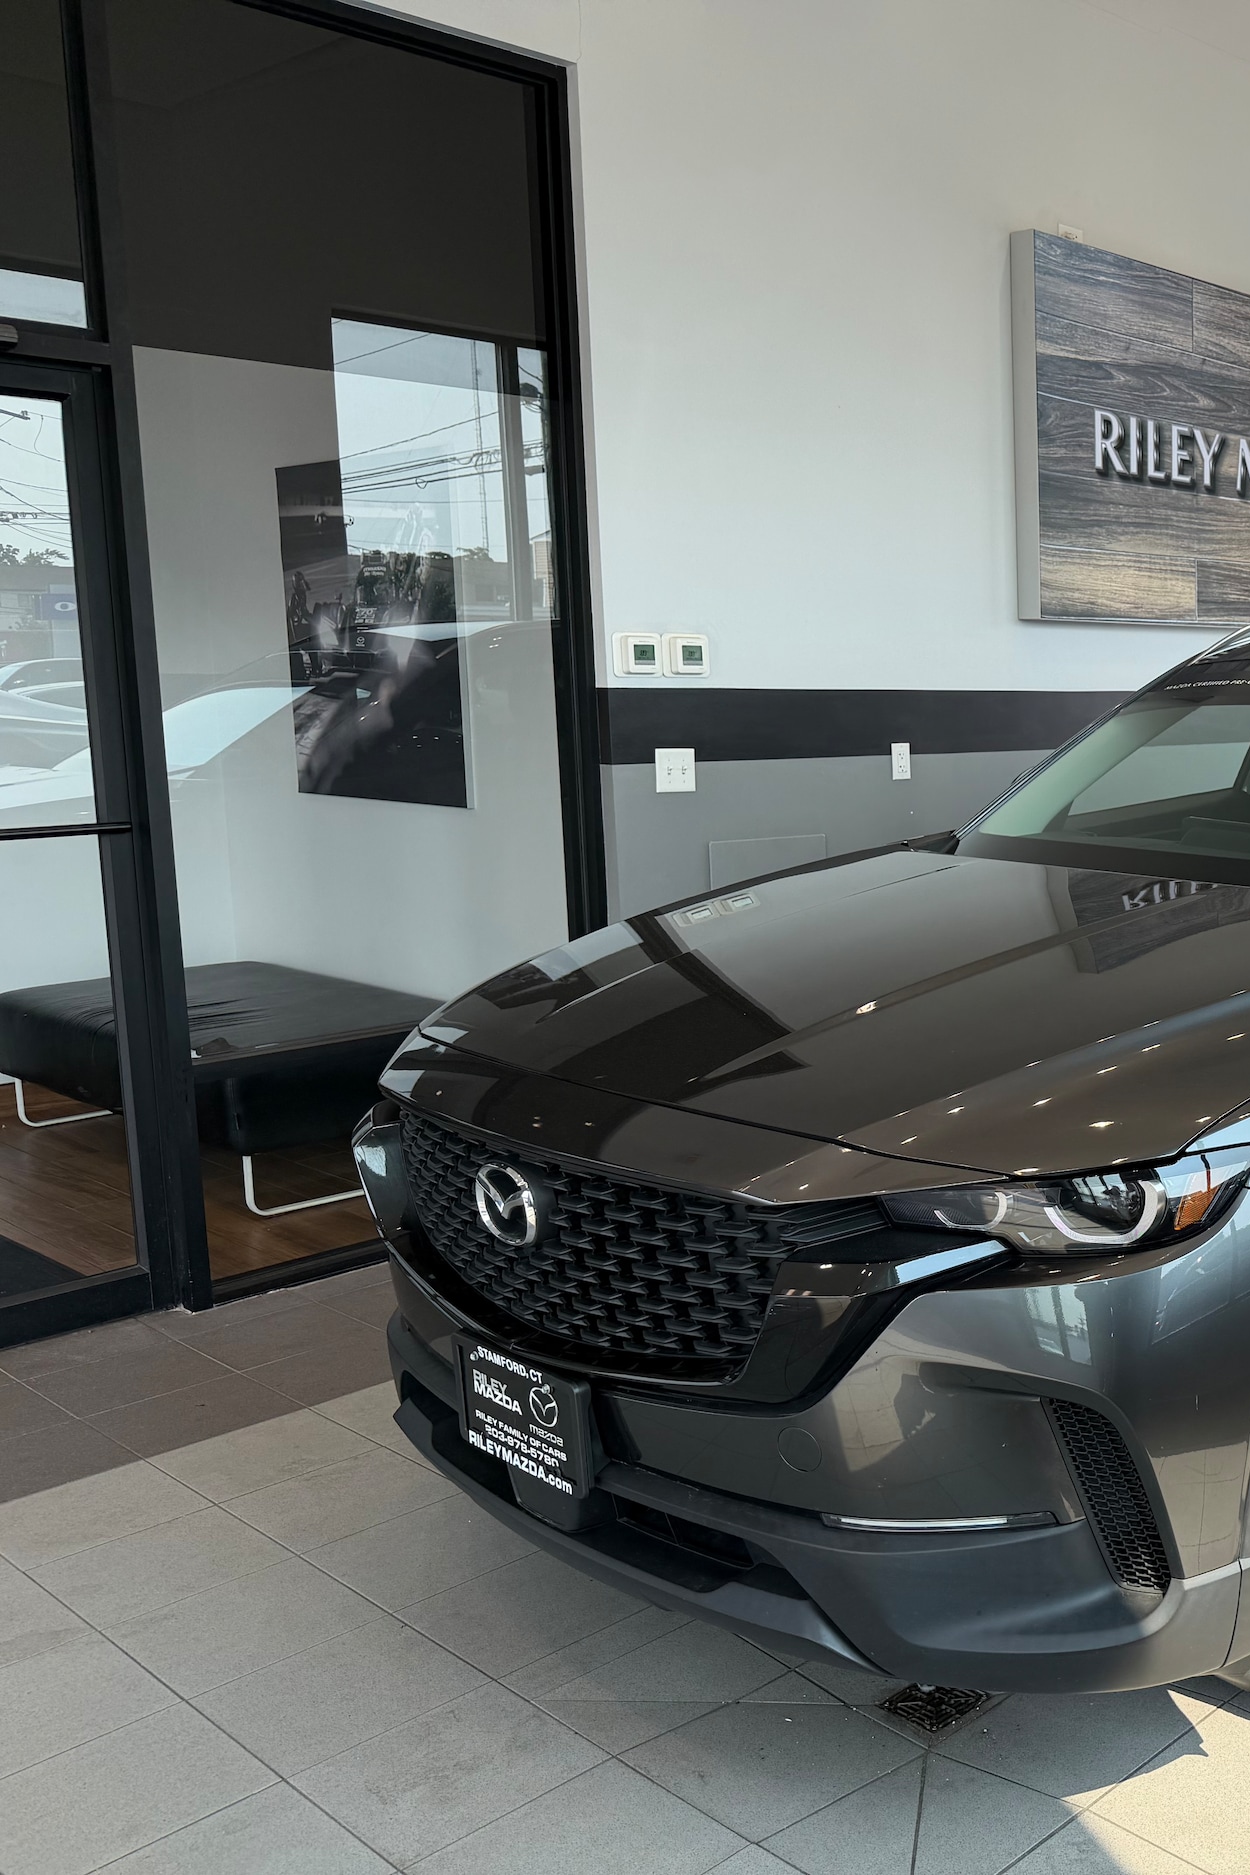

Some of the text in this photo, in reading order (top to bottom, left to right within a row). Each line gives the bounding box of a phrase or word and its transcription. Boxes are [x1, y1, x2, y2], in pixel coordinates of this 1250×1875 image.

[1093, 408, 1225, 490] RILEY
[472, 1369, 507, 1396] RILEY
[477, 1345, 543, 1384] STAMFORD, CT
[474, 1380, 523, 1416] MAZDA
[475, 1409, 567, 1462] RILEY FAMILY OF CARS
[468, 1429, 573, 1495] RILEYMAZDA.com
